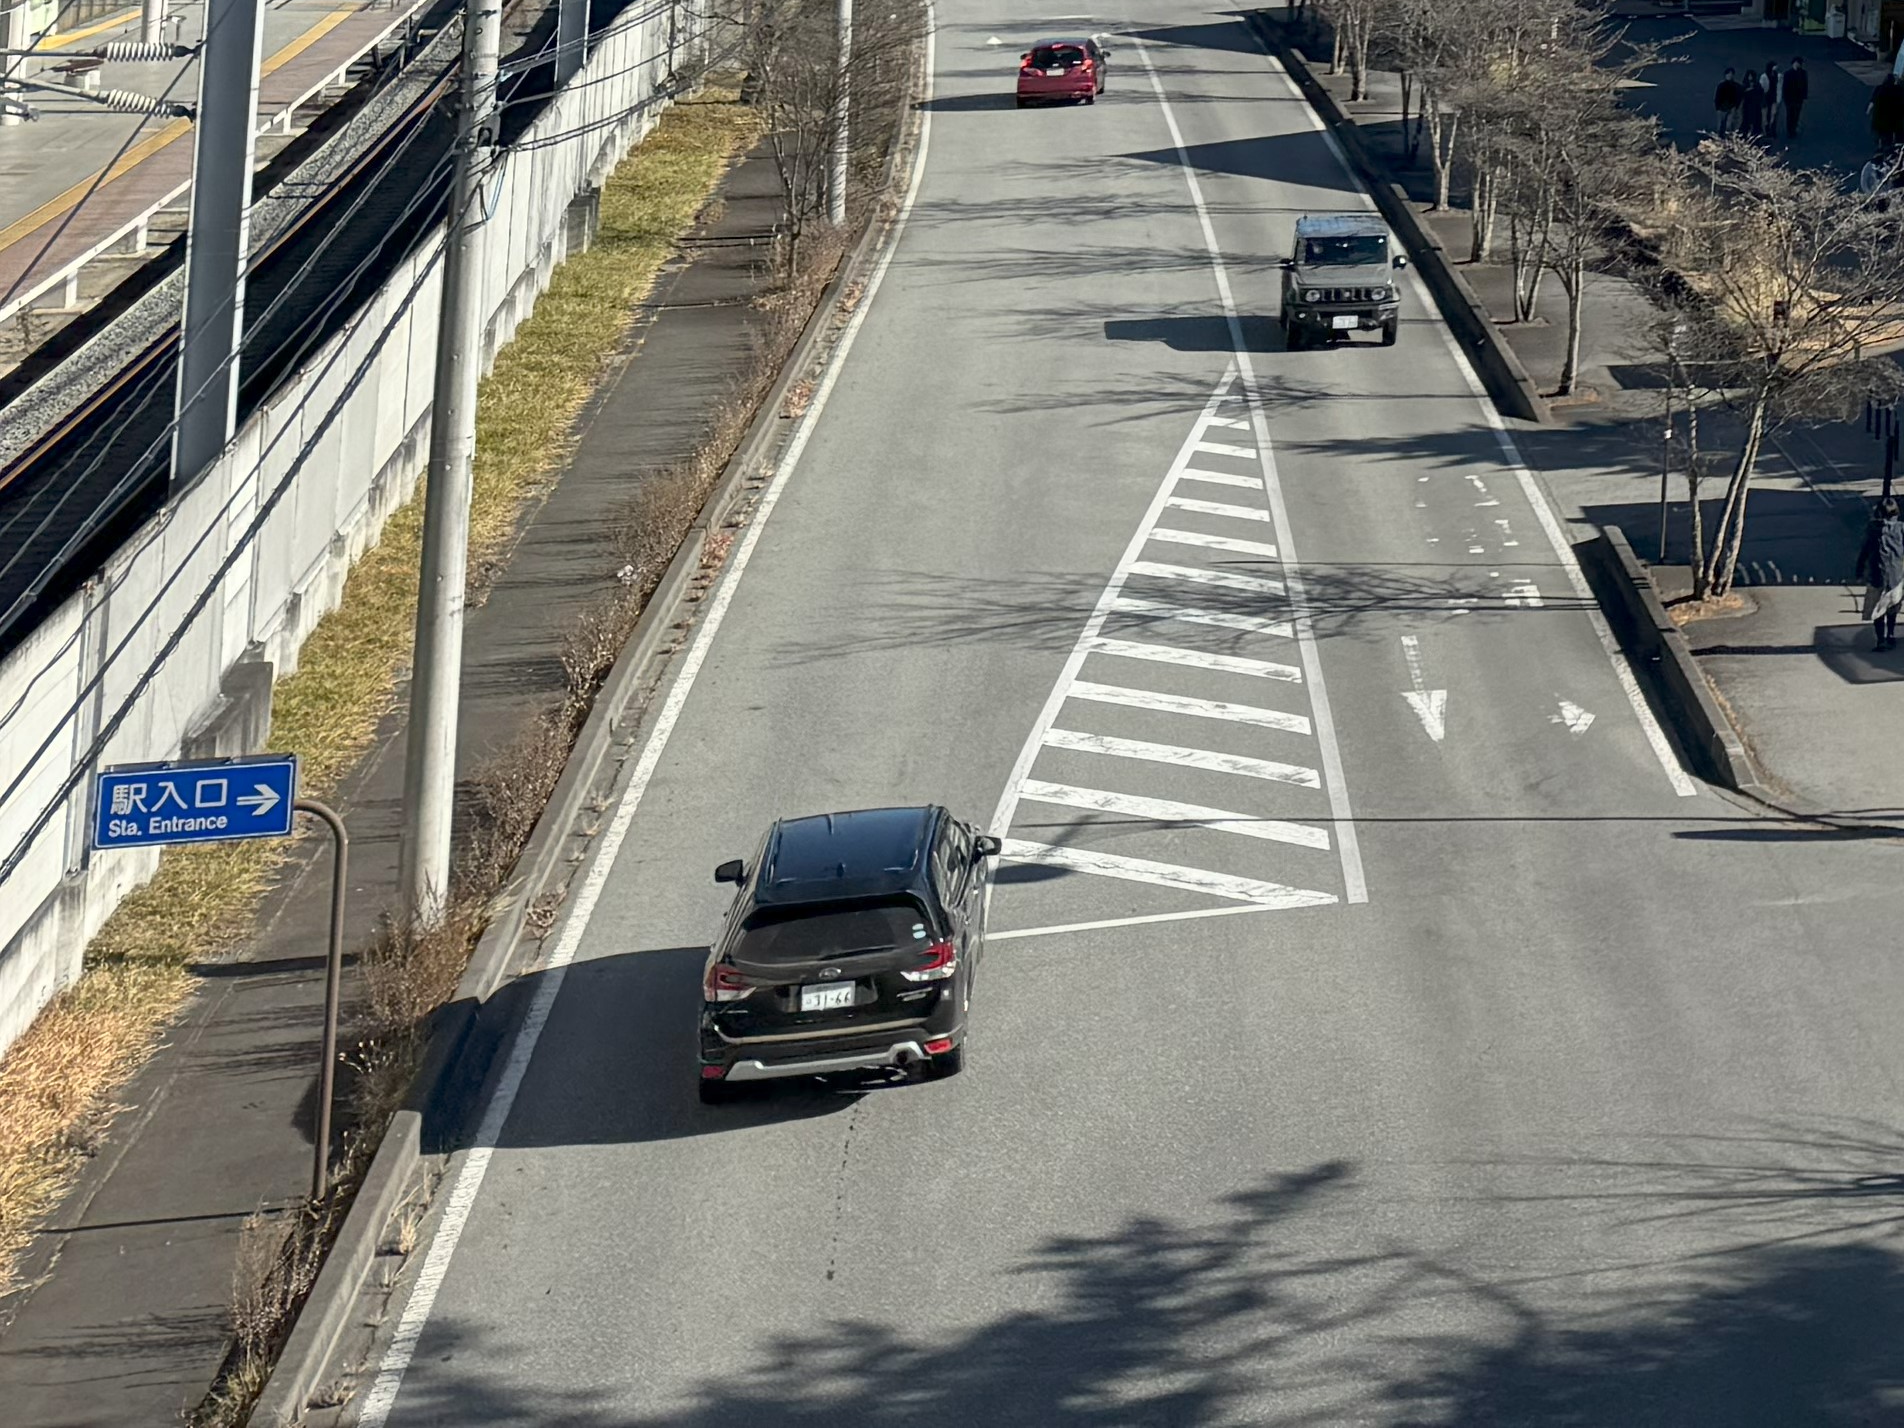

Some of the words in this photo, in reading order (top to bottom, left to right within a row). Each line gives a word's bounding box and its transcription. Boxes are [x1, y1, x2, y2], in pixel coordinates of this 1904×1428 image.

[110, 778, 228, 815] 駅入口
[108, 819, 142, 838] Sta.
[149, 816, 228, 834] Entrance
